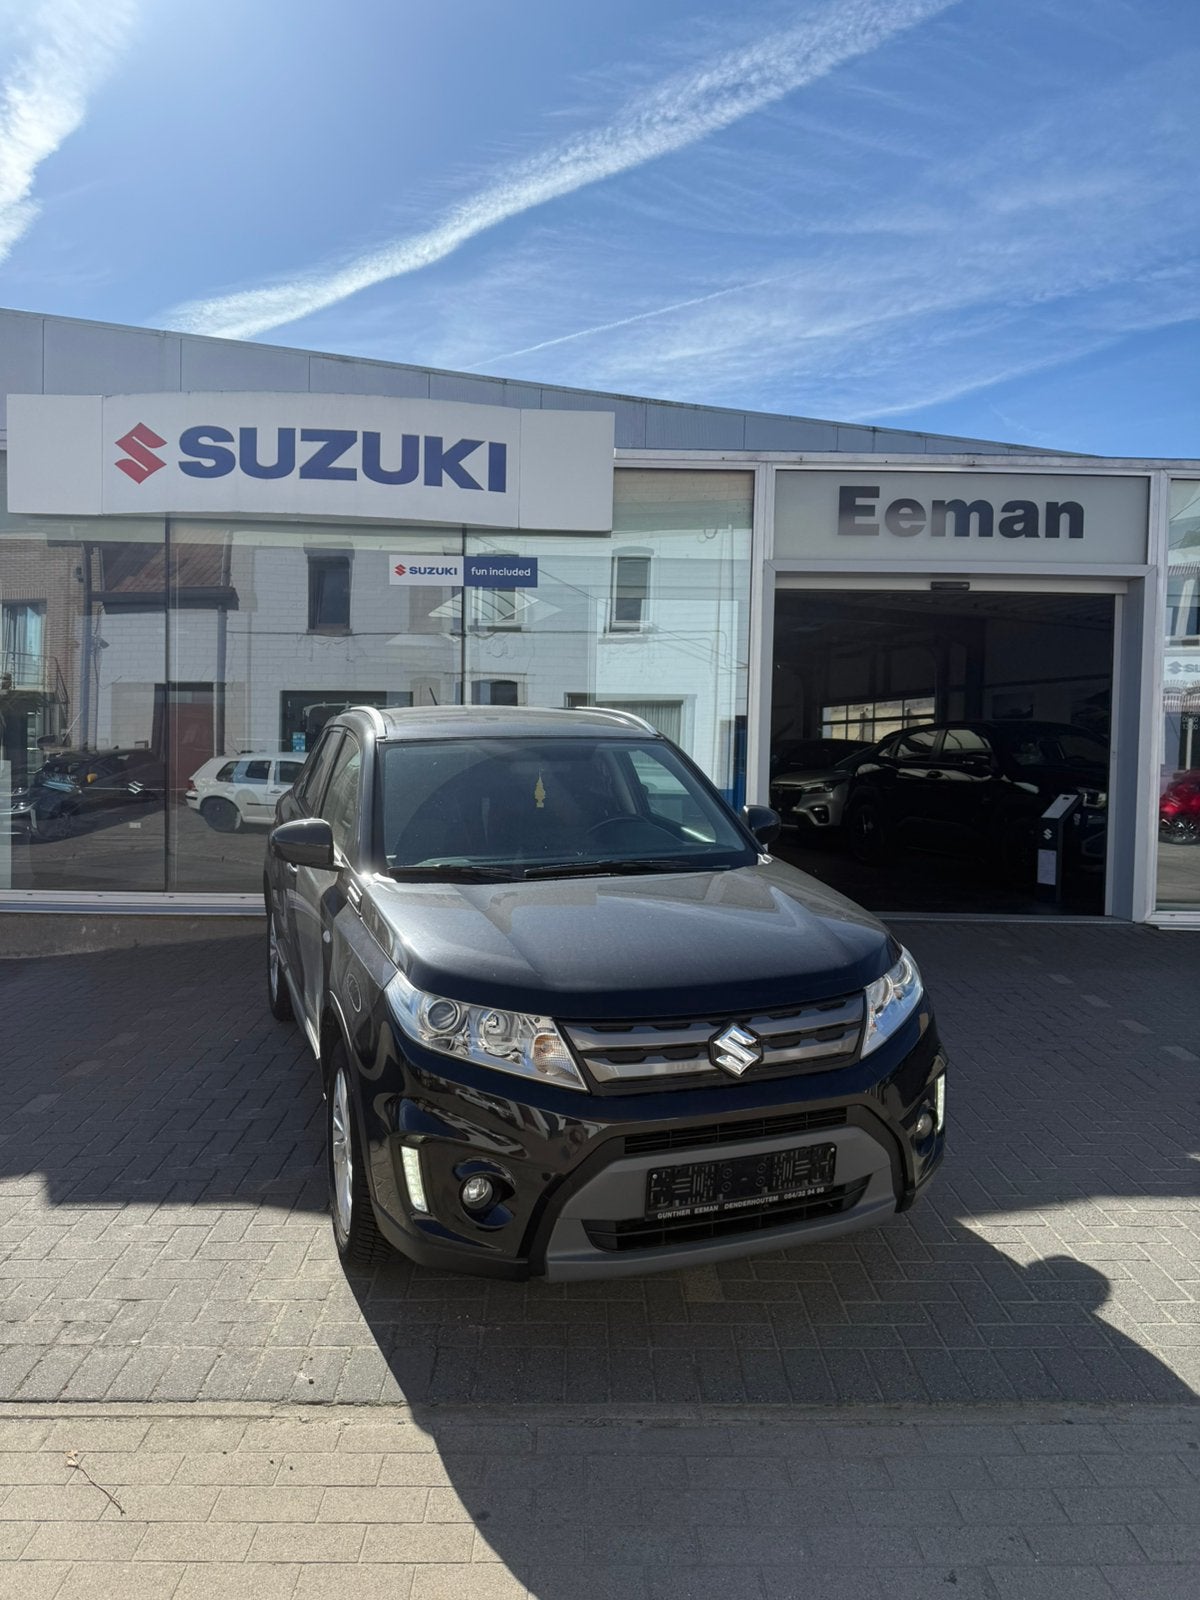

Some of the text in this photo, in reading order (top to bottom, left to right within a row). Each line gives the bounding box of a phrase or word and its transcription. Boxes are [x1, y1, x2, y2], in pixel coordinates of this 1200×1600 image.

[178, 425, 507, 493] SUZUKI
[837, 485, 1085, 539] Eeman
[409, 566, 458, 576] SUZUKI
[471, 566, 531, 577] fun included
[657, 1208, 691, 1220] GUNTHER
[694, 1205, 719, 1215] EEMAN
[724, 1194, 779, 1210] DENDERHOUTEM
